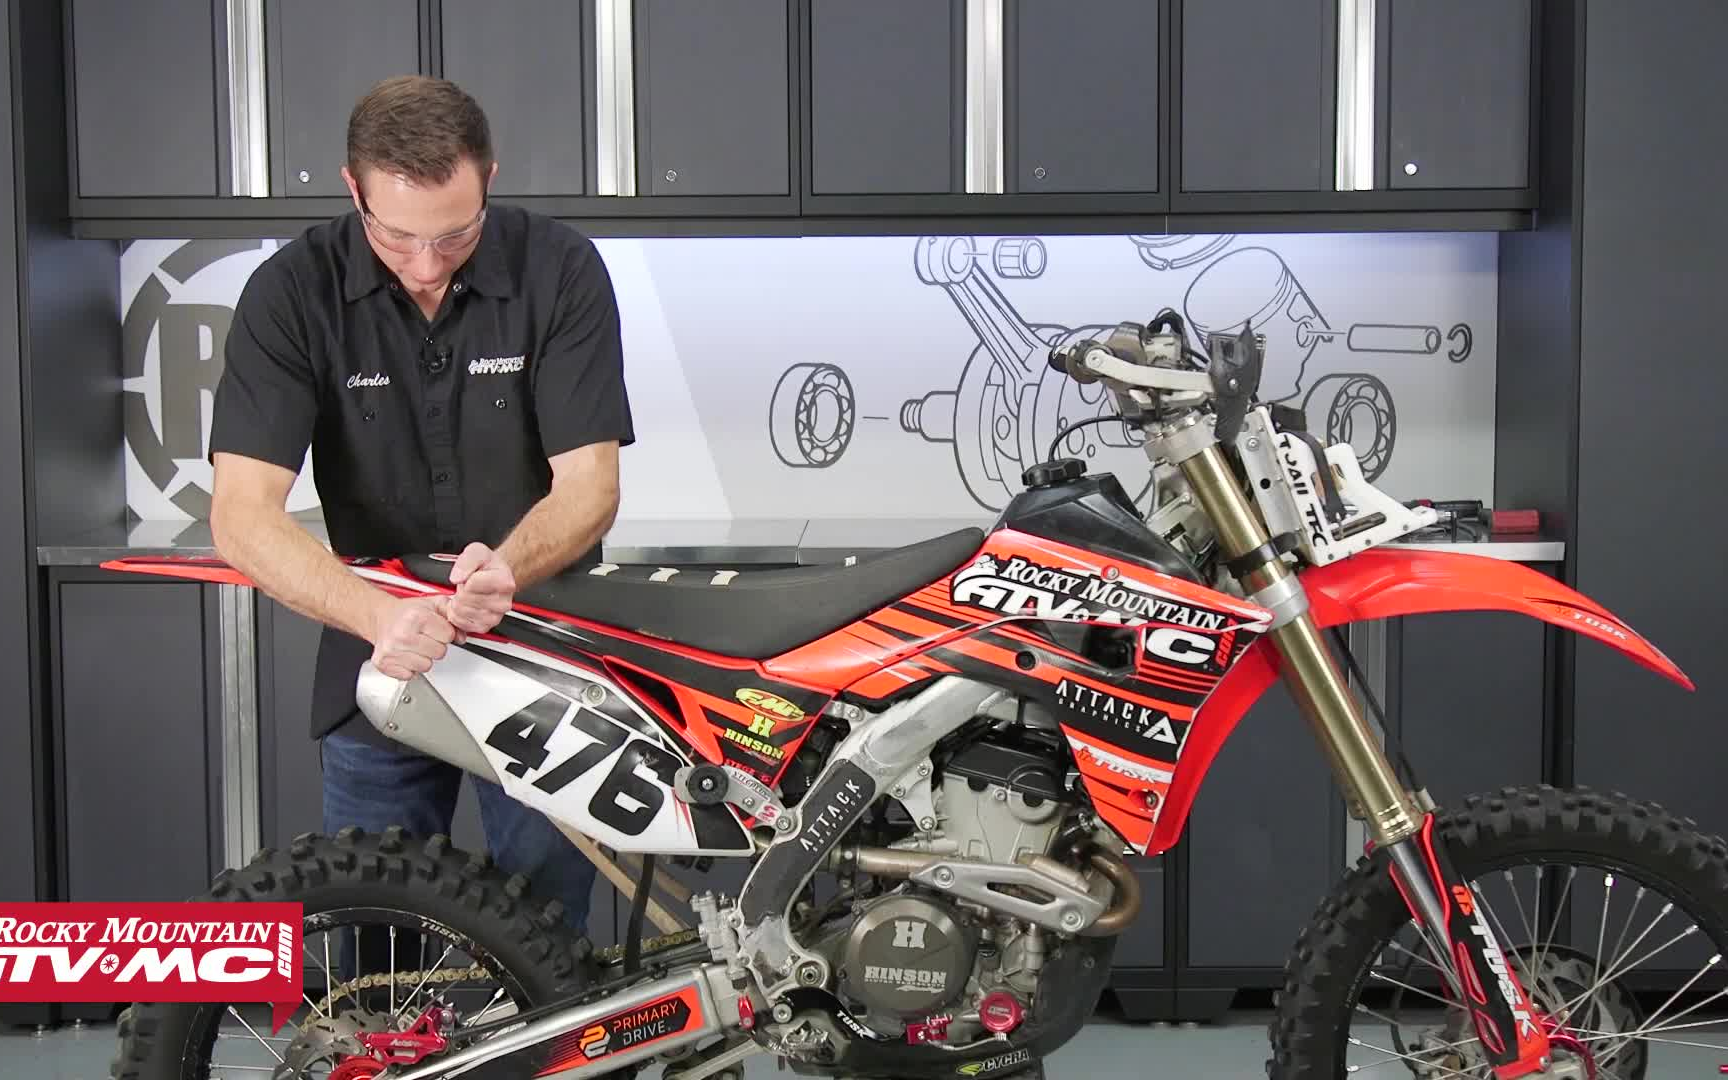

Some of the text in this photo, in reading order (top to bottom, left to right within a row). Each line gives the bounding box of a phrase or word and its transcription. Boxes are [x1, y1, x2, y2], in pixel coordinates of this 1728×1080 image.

[347, 372, 390, 389] Charles
[1001, 557, 1225, 630] ROCKY MOUNTAIN
[1573, 611, 1628, 640] TUSK
[1056, 680, 1152, 726] ATTACK
[724, 728, 785, 759] HINSON
[485, 692, 684, 836] 476
[800, 779, 859, 851] ATTACK
[864, 965, 947, 984] HINSON
[1470, 906, 1539, 1041] TUSK
[613, 1001, 678, 1033] PRIMARY
[837, 1010, 864, 1039] TUSK
[982, 1048, 1029, 1072] CYCRA
